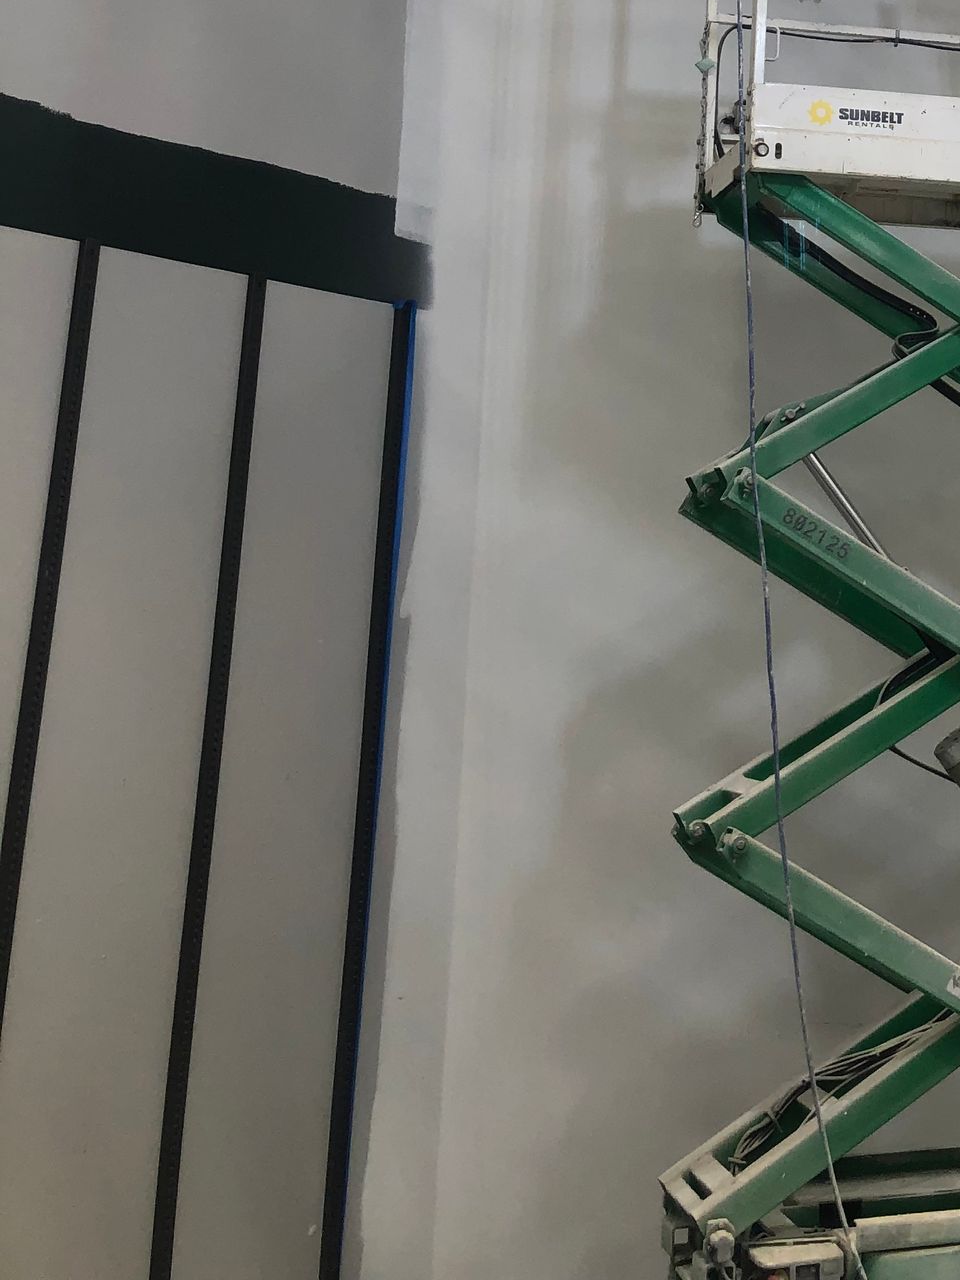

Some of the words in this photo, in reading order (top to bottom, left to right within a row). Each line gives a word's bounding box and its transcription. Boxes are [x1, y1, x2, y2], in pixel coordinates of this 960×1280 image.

[839, 108, 904, 124] SUNBELT
[848, 121, 894, 130] RENTALS
[784, 508, 850, 558] 802125
